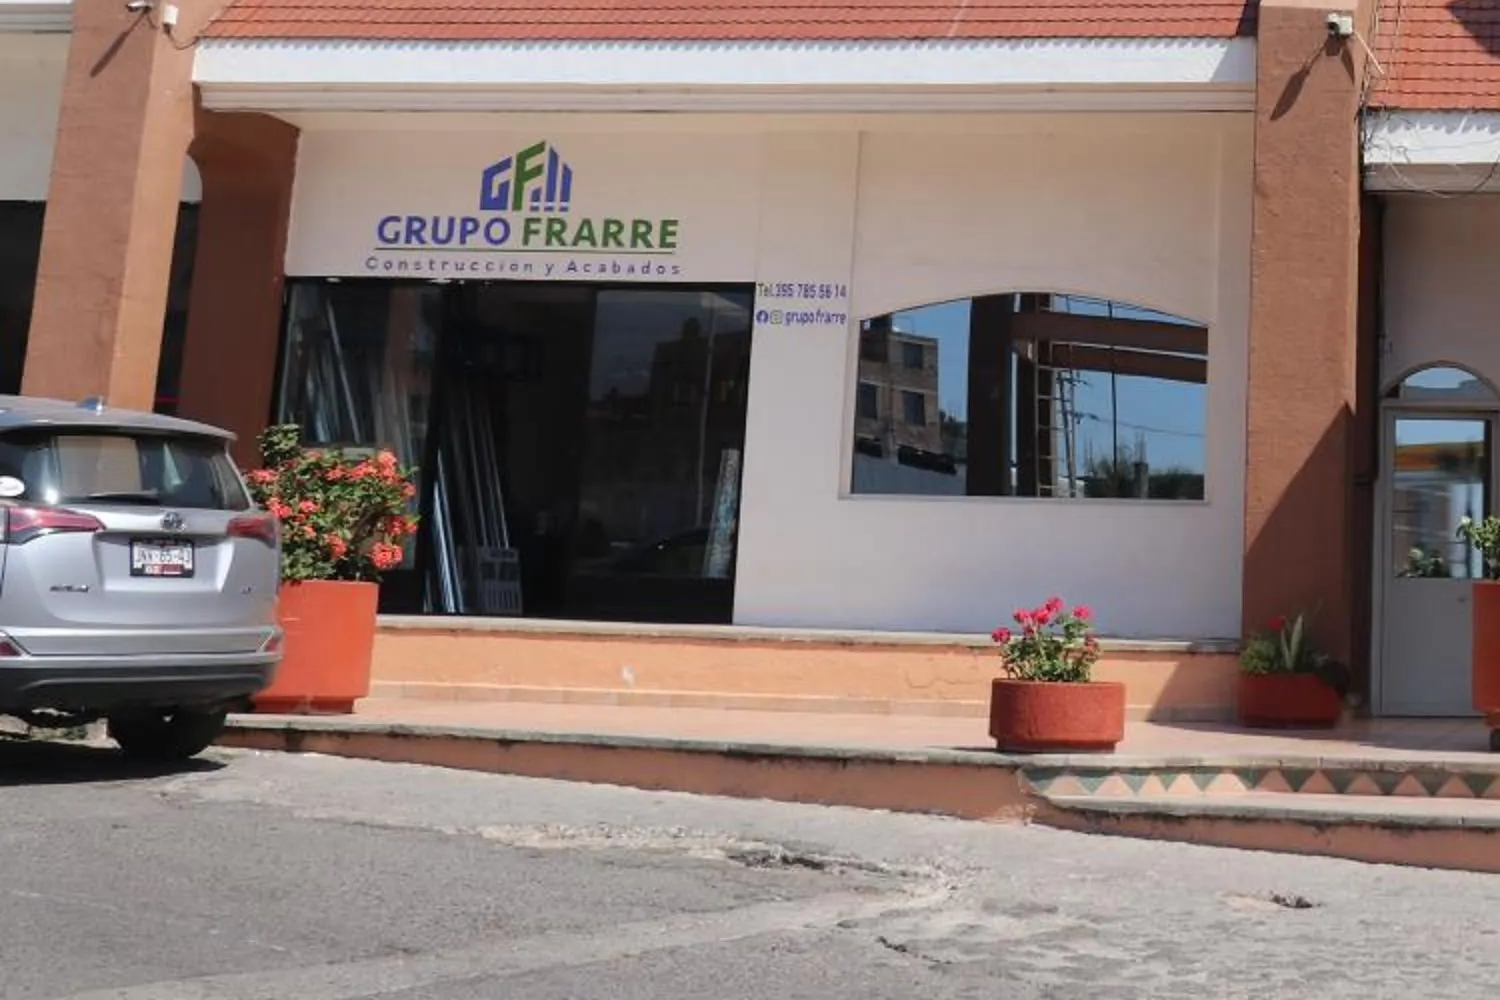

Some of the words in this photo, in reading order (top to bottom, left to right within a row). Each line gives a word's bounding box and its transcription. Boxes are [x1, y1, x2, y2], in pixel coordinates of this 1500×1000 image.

[377, 215, 511, 245] GRUPO
[522, 217, 679, 248] FRARRE
[544, 262, 555, 277] y
[566, 259, 681, 275] Acabados
